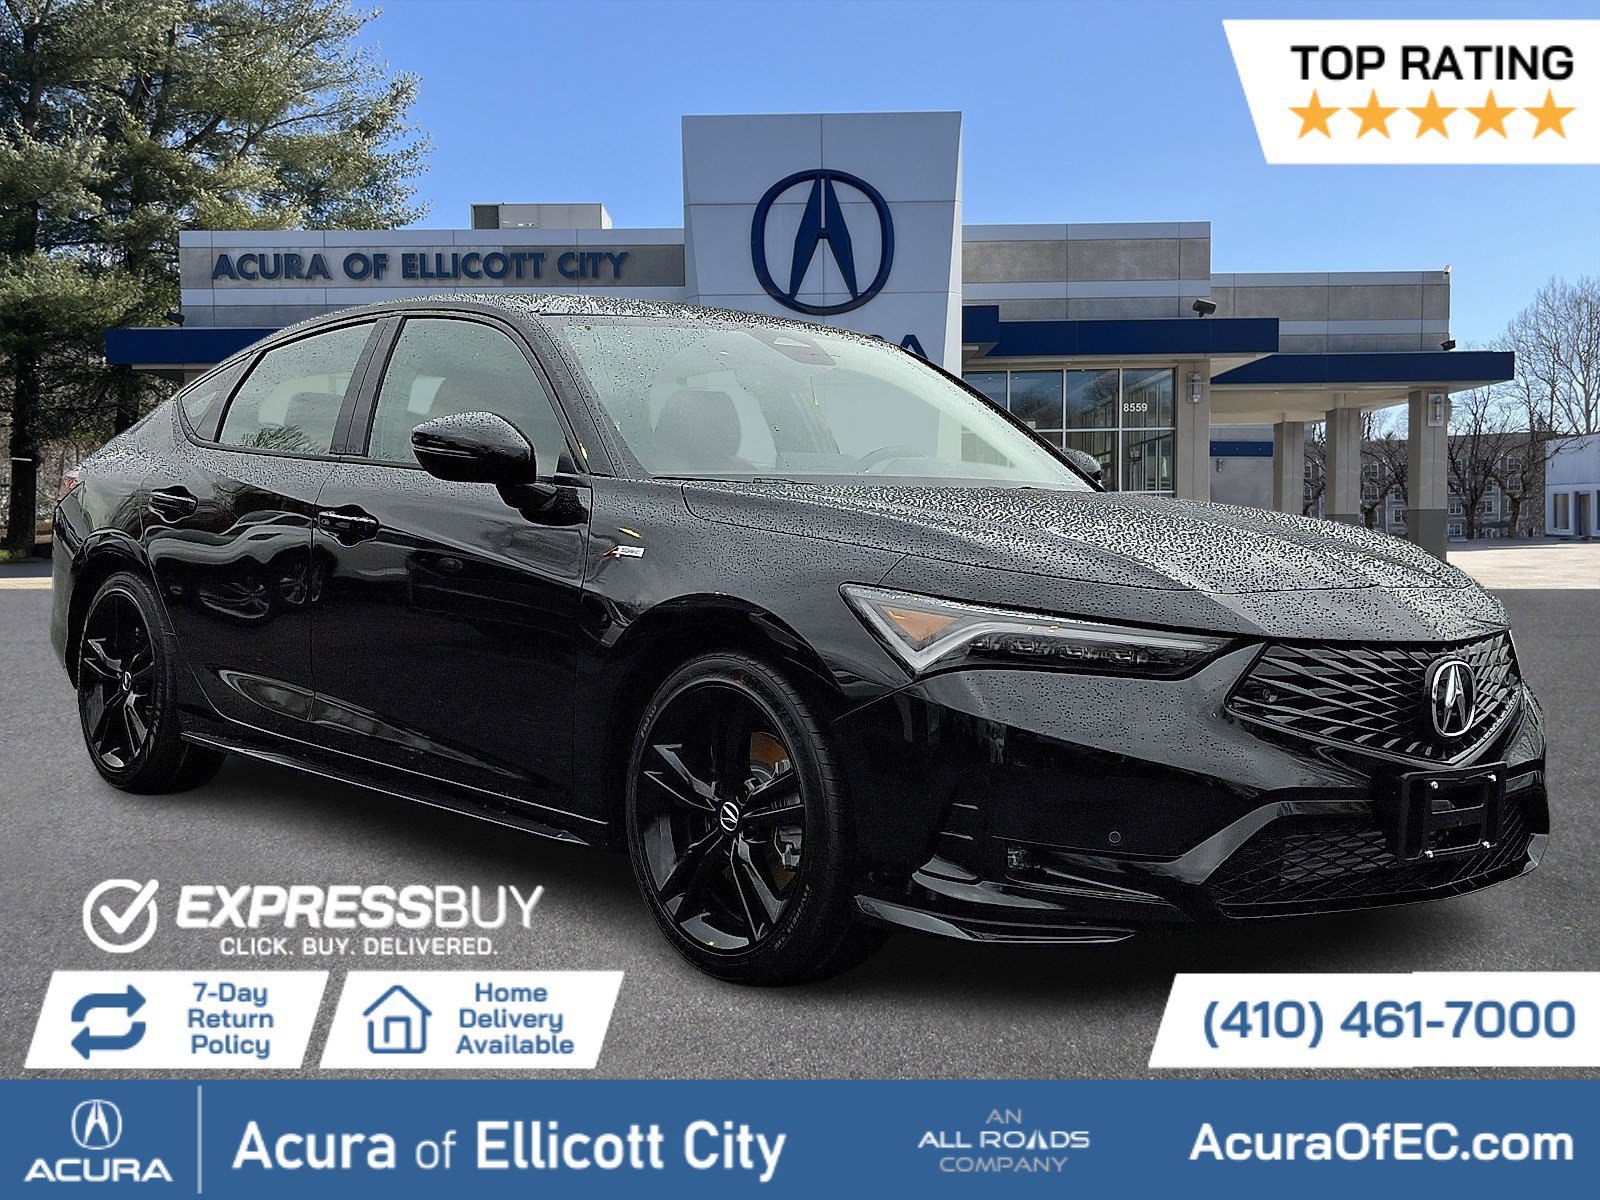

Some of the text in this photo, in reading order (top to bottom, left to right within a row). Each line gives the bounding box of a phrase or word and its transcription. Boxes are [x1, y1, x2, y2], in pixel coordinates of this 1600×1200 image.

[212, 252, 628, 280] ACURA OF ELLICOTT CITY
[1123, 402, 1148, 412] 8559
